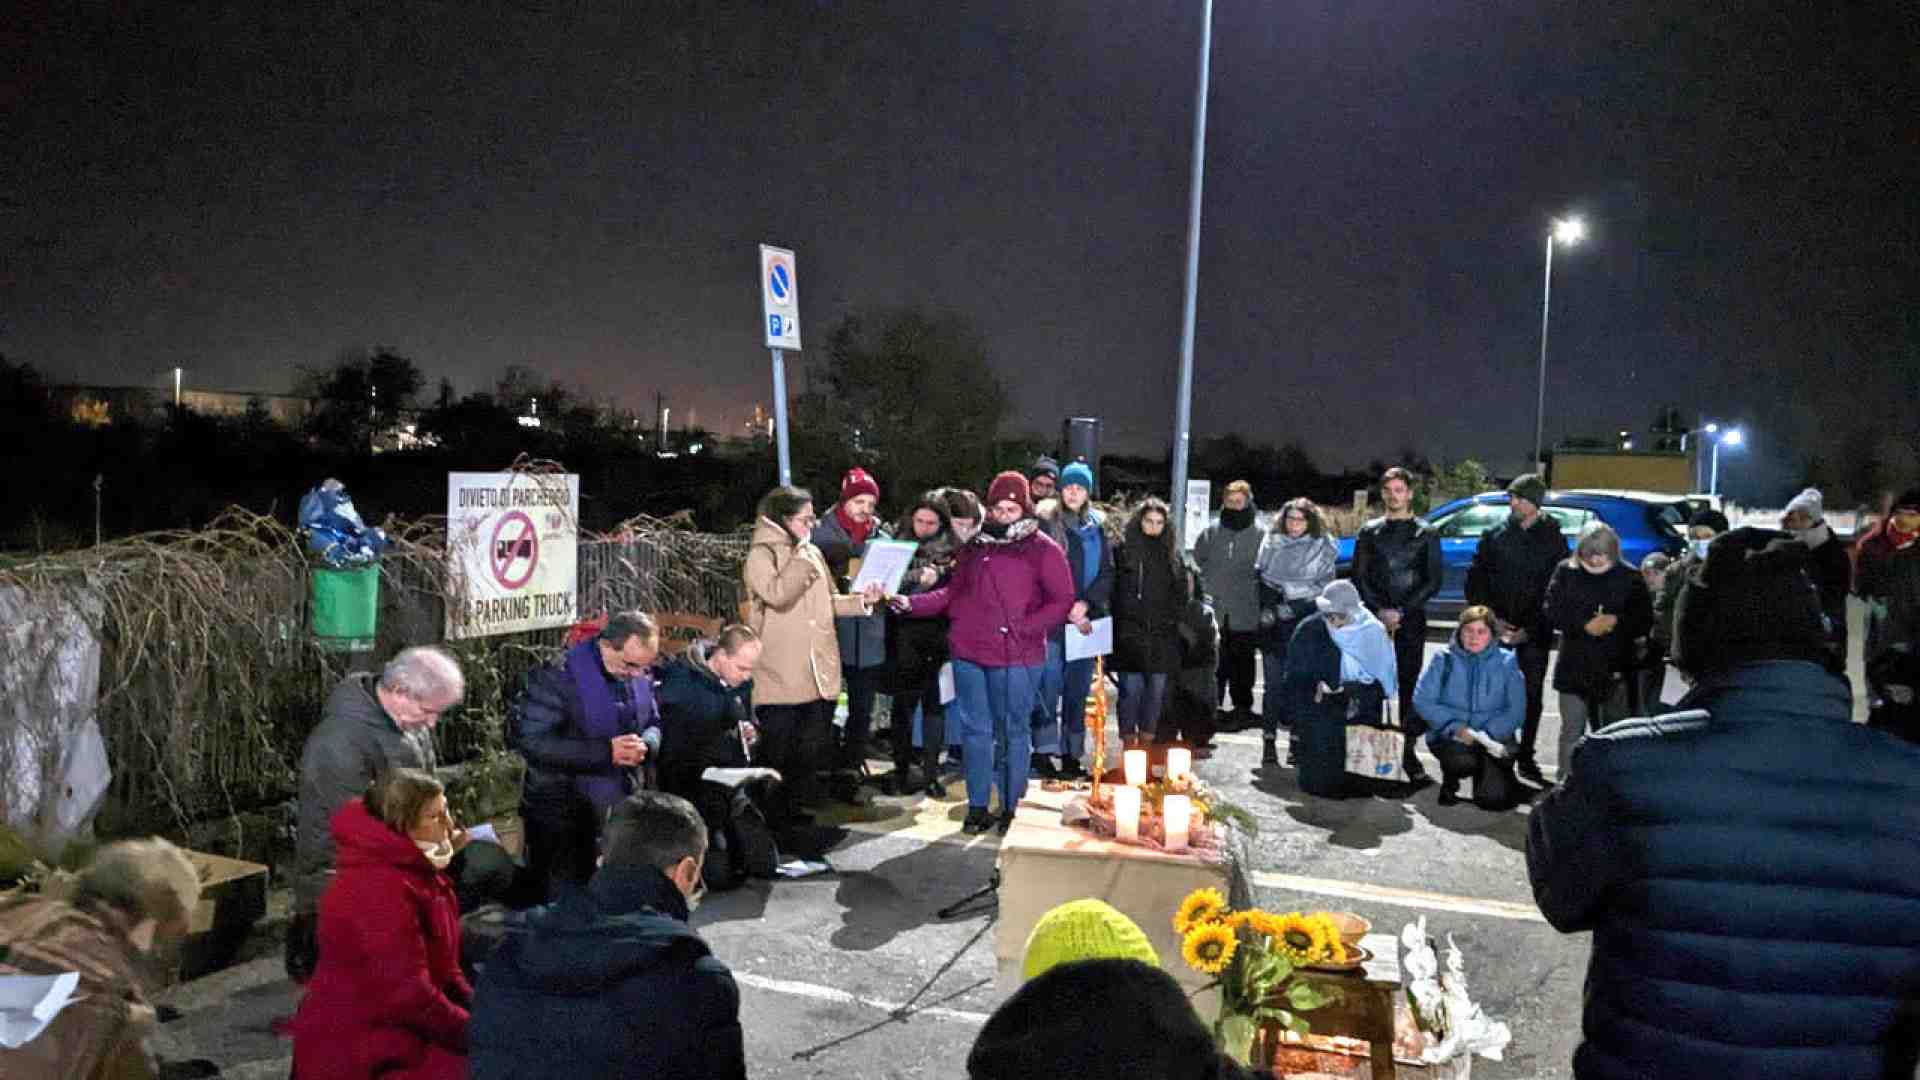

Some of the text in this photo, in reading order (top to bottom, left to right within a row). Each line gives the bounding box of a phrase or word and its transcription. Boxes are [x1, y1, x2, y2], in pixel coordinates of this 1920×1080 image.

[458, 488, 497, 507] DIVIETO
[476, 595, 529, 624] PARKING
[533, 591, 572, 617] TRUCK
